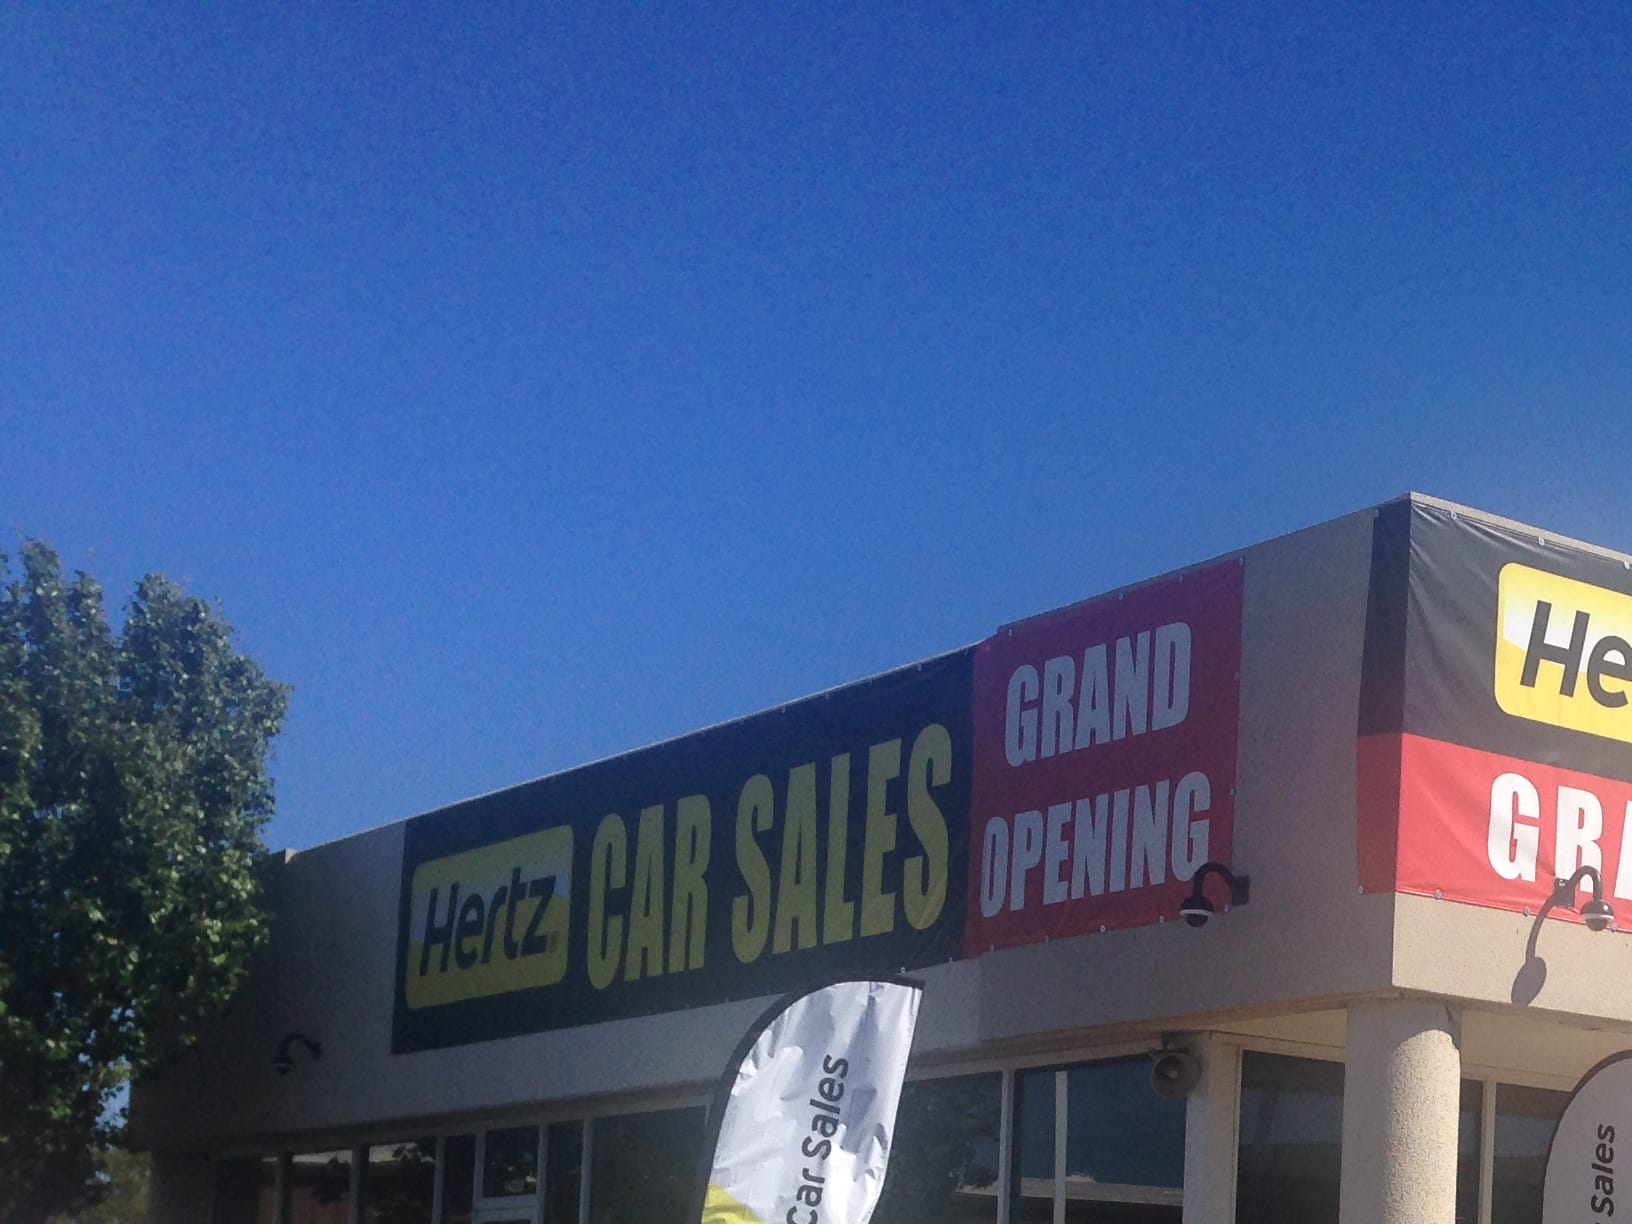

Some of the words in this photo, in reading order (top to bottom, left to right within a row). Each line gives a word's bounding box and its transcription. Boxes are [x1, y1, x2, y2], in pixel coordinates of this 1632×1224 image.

[1004, 620, 1191, 767] GRAND
[419, 867, 556, 976] Hertz
[586, 793, 713, 990] CAR
[730, 722, 953, 966] SALES
[979, 770, 1212, 919] OPENING
[801, 1054, 850, 1161] Sales
[1591, 1123, 1617, 1218] Sales
